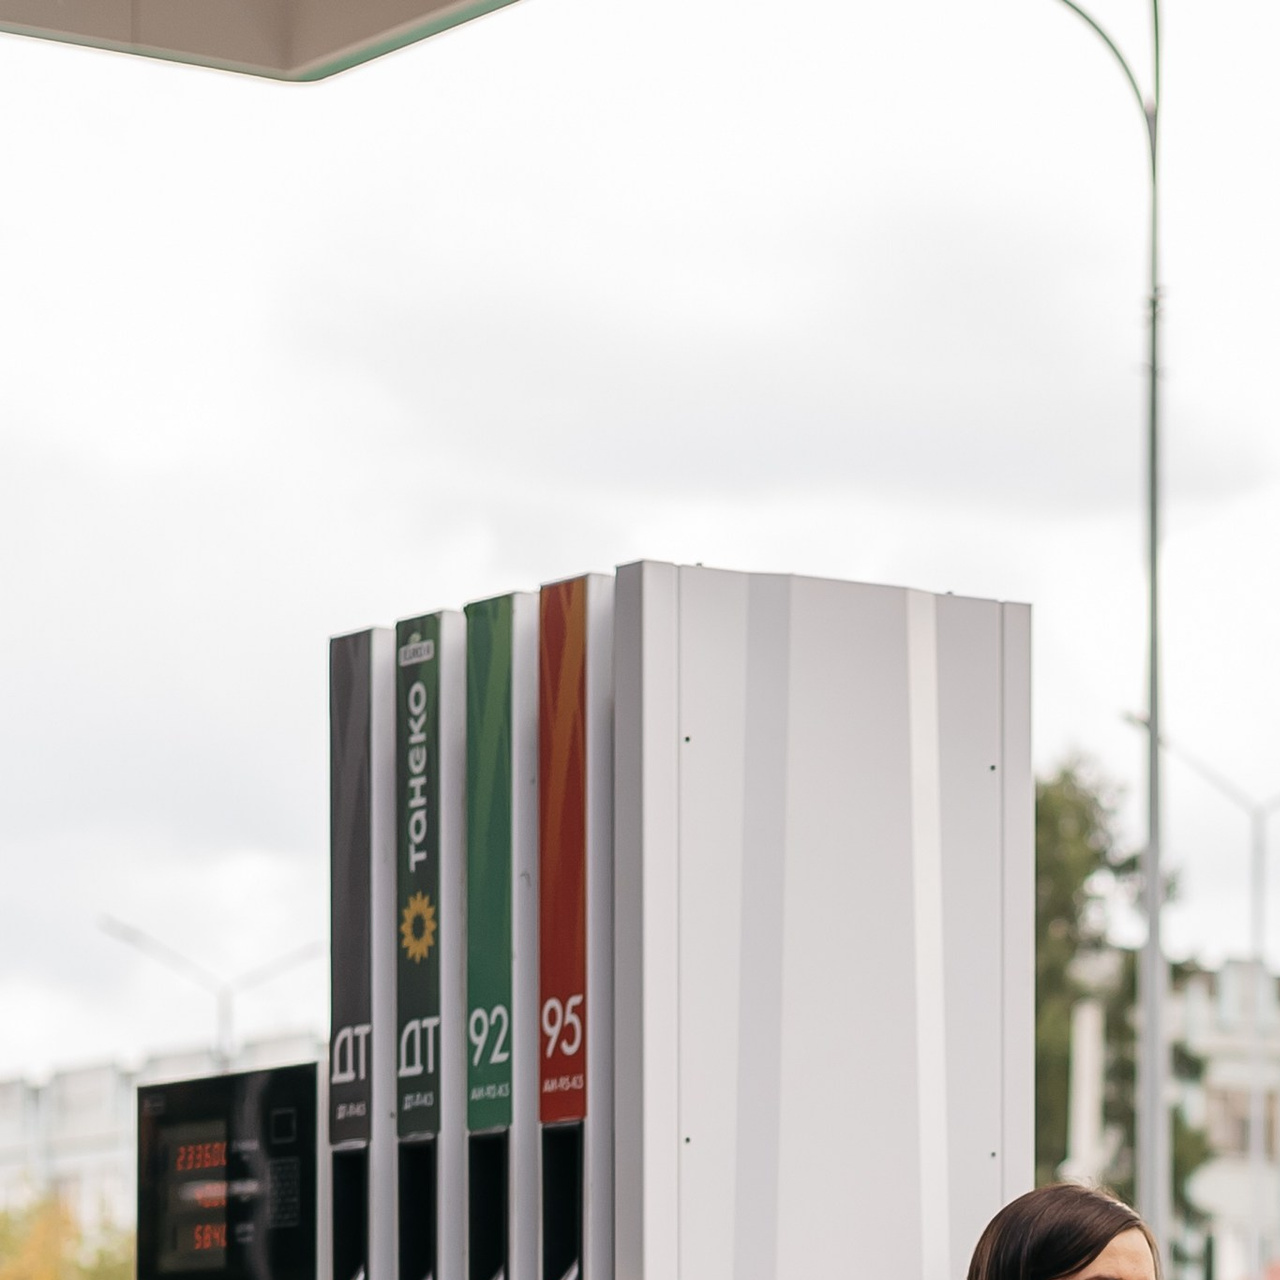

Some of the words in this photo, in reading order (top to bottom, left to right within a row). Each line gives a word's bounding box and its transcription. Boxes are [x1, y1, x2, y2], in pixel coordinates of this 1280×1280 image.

[331, 1025, 372, 1084] ДТ
[398, 1017, 440, 1077] ДТ
[468, 1003, 511, 1068] 92
[541, 994, 584, 1059] 95
